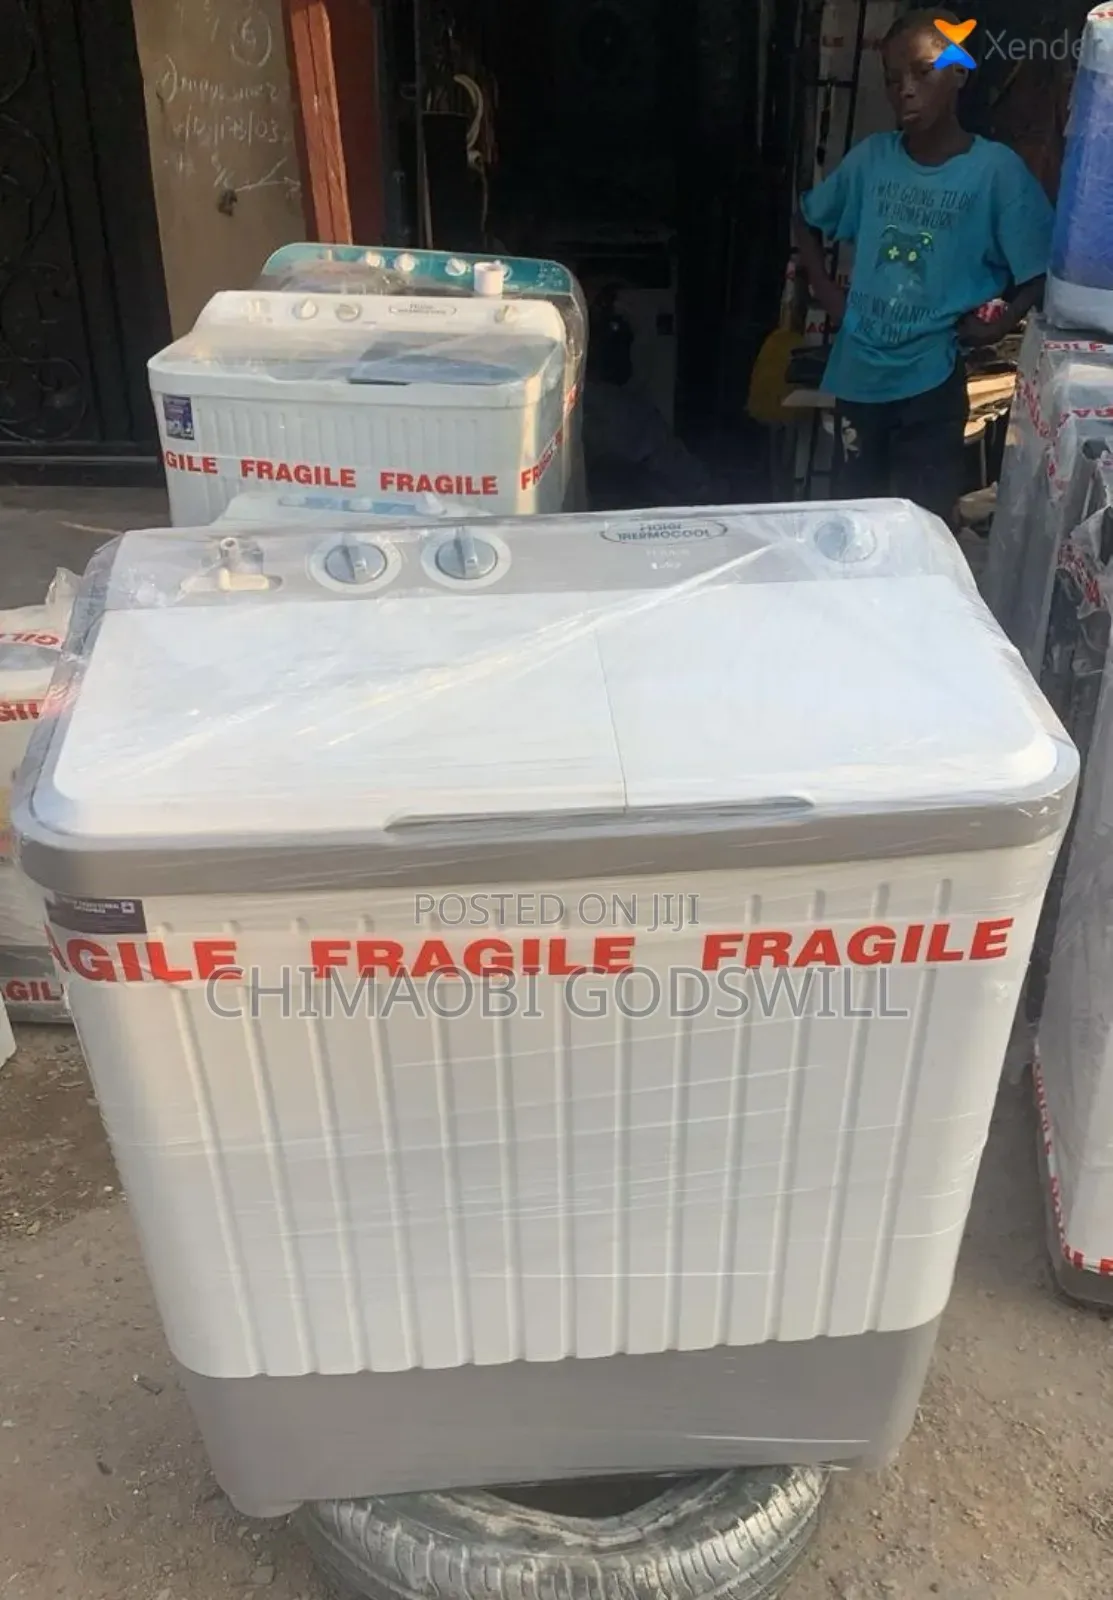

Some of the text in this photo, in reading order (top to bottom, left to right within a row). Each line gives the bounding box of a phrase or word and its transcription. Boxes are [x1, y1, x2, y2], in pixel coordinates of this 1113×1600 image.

[901, 185, 934, 207] GOING
[240, 459, 357, 488] FRAGILE
[379, 471, 499, 495] FRAGILE
[308, 932, 636, 980] FRAGILE
[701, 917, 1014, 972] FRAGILE
